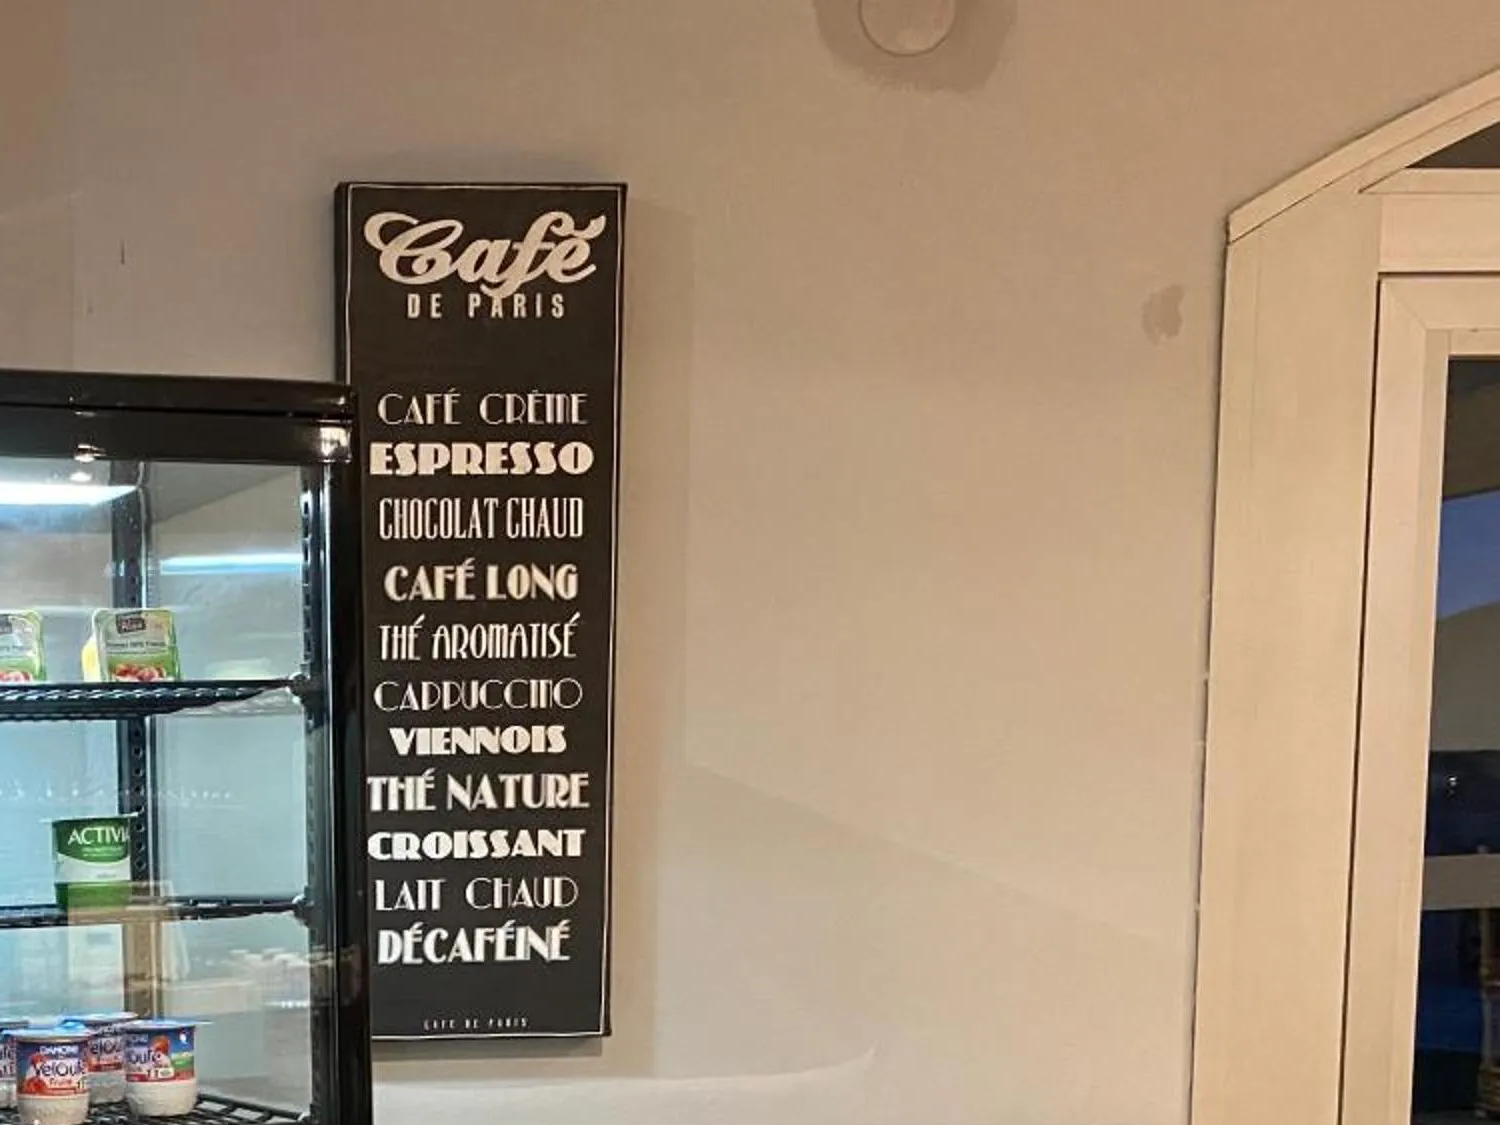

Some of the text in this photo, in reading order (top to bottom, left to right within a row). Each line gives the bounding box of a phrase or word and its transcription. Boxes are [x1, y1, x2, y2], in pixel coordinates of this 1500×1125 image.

[363, 210, 607, 299] Café
[406, 293, 565, 319] DE PARIS
[377, 388, 590, 426] CAFÉ CRÈME
[368, 441, 596, 477] ESPRESSO
[378, 497, 585, 541] CHOCOLAT CHAUD
[383, 557, 580, 601] CAFÉ LONG
[379, 611, 582, 661] THÉ AROMATISÉ
[373, 677, 584, 712] CAPPUCCINO
[388, 724, 568, 756] VIENNOIS
[366, 767, 591, 812] THÉ NATURE
[366, 829, 587, 861] CROISSANT
[374, 876, 580, 912] LAIT CHAUD
[377, 919, 572, 965] DÉCAFÉINÉ
